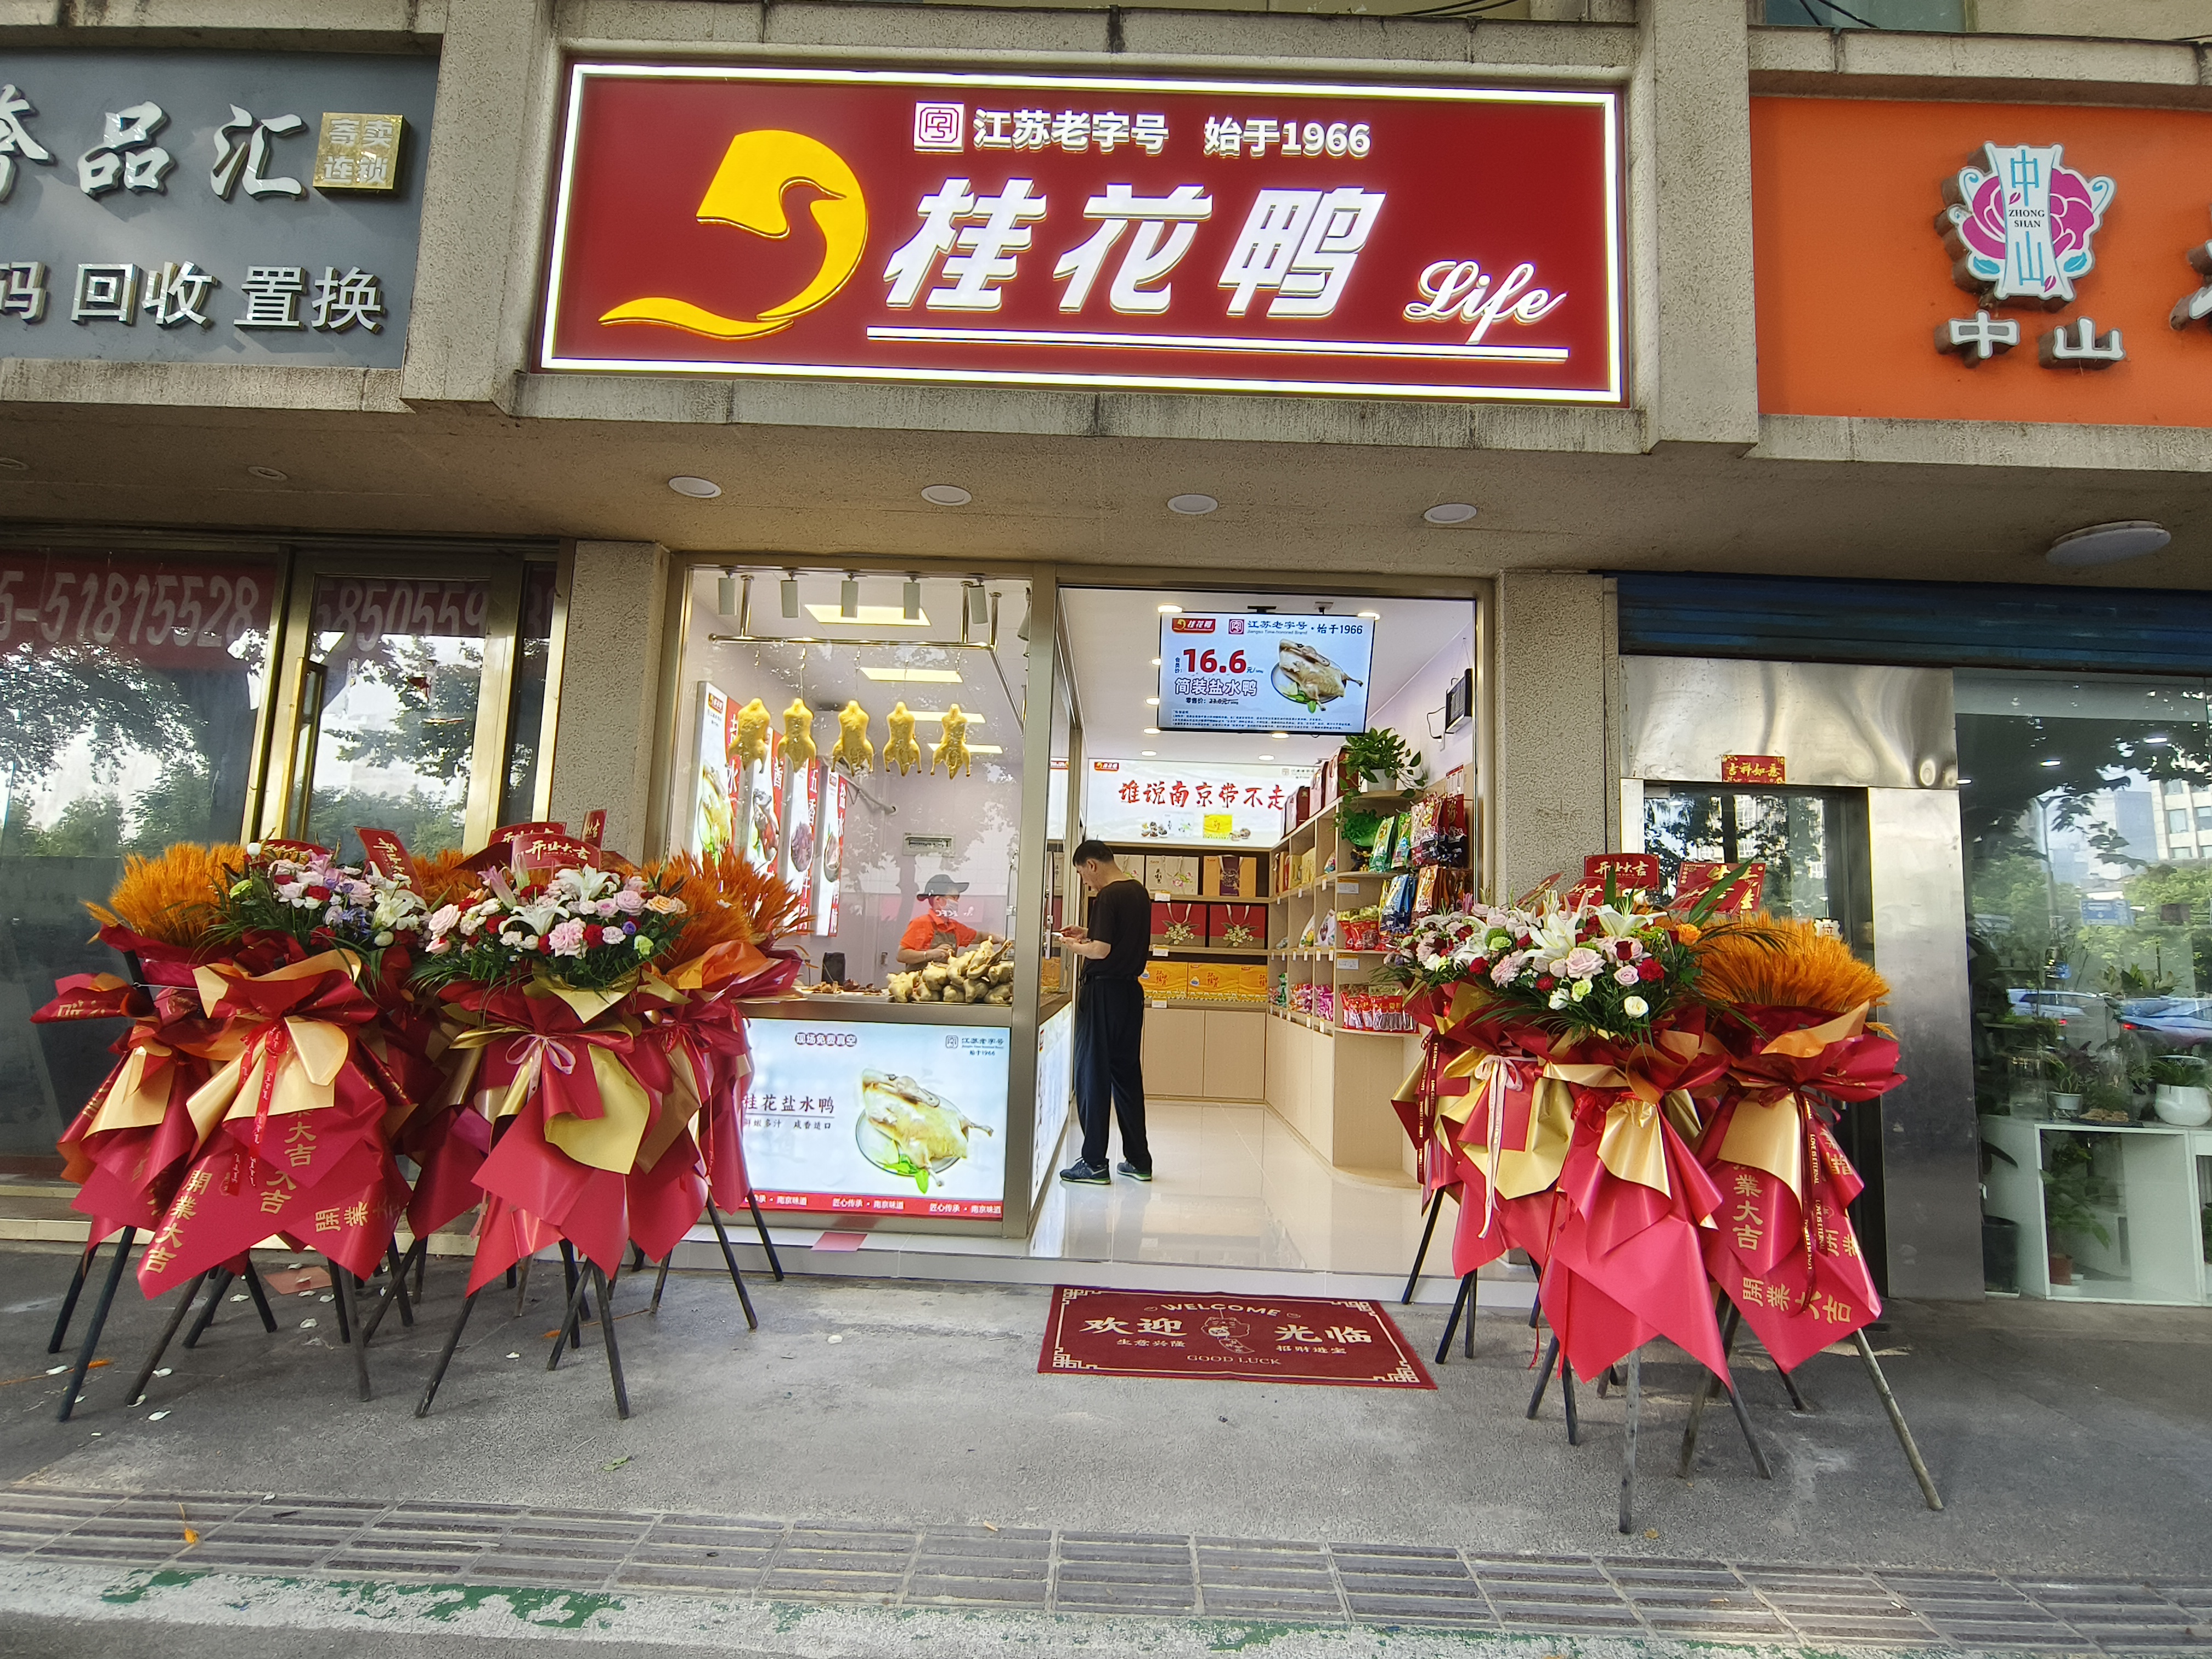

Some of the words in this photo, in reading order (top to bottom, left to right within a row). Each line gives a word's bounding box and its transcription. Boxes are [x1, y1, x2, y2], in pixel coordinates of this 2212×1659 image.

[329, 118, 393, 148] 寄卖
[973, 108, 1170, 156] 江苏老字号
[1203, 115, 1372, 159] 始于1966
[323, 151, 388, 184] 连锁
[2008, 209, 2045, 217] ZHONG
[882, 177, 1387, 319] 桂花鸭
[1403, 260, 1568, 346] Life
[71, 261, 217, 328] 回收
[234, 266, 385, 332] 置换
[1948, 309, 2126, 359] 中山
[1247, 620, 1307, 630] 江苏老字号
[1183, 648, 1247, 674] 16.6
[1175, 678, 1257, 696] 简装盐水鸭
[1118, 779, 1286, 811] 谁说南京带不走
[525, 839, 591, 861] 开业大吉
[743, 1093, 834, 1114] 桂花盐水鸭
[1732, 1164, 1764, 1251] 業大吉
[145, 1170, 213, 1274] 開業大吉
[1160, 1303, 1281, 1317] WELCOME
[1079, 1316, 1188, 1337] 欢迎
[1274, 1323, 1372, 1344] 光临
[1187, 1354, 1234, 1363] GOOD
[1238, 1357, 1282, 1365] LUCK
[1276, 1344, 1347, 1355] 招财进宝
